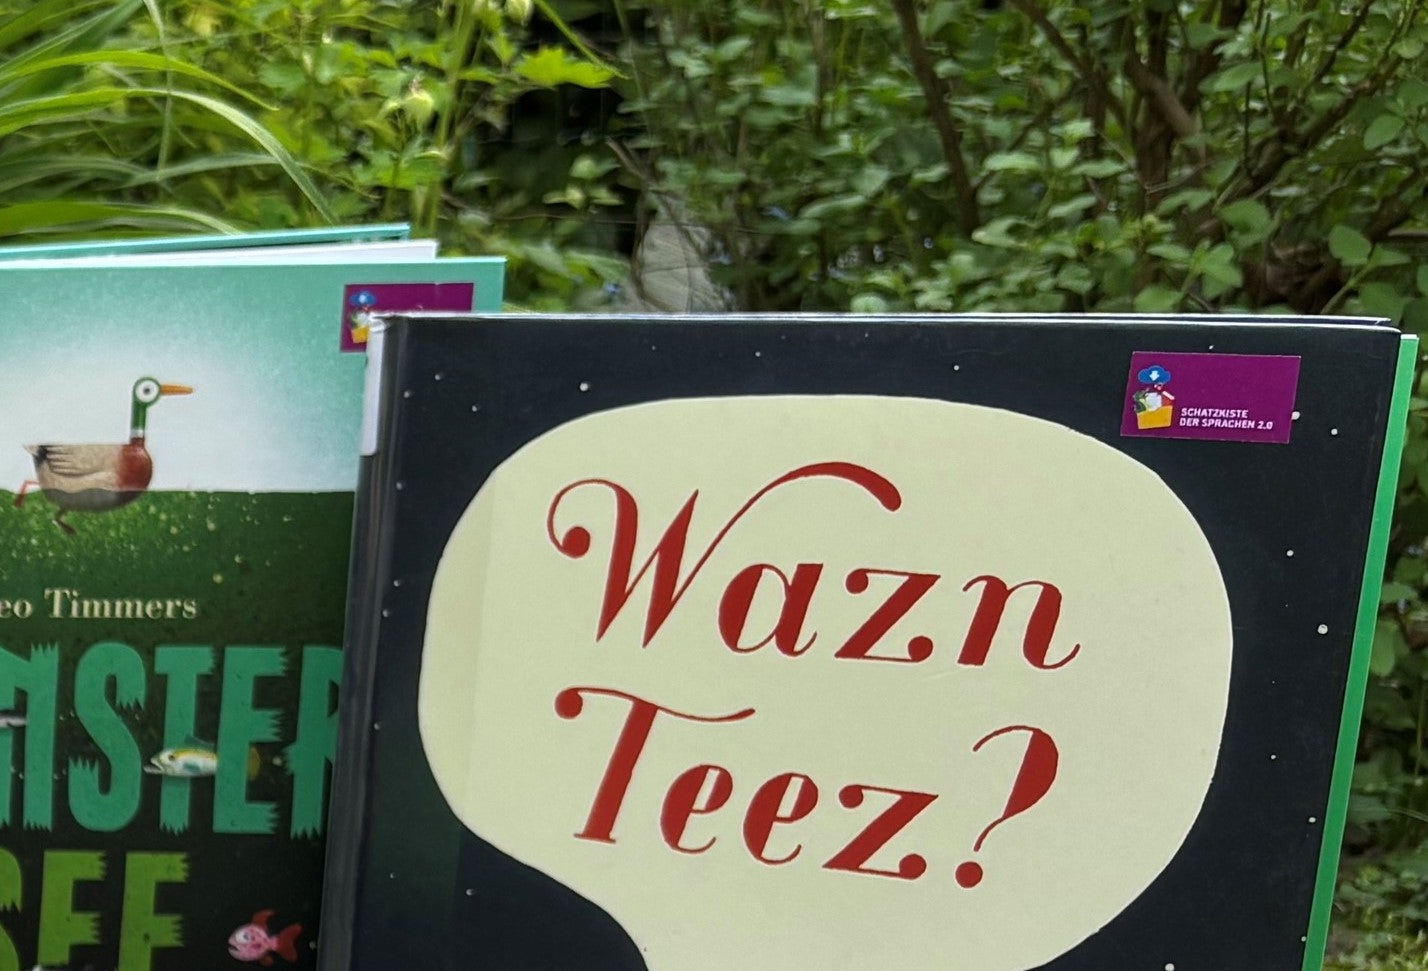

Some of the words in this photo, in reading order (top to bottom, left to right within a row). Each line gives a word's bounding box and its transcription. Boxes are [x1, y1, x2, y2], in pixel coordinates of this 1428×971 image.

[1179, 417, 1200, 427] DER
[1202, 418, 1255, 429] SPRACHEN
[1257, 421, 1273, 430] 2.0
[1181, 407, 1249, 419] SCHATZKISTE
[547, 461, 1081, 670] Wazn
[44, 587, 197, 620] Timmers
[554, 685, 1060, 889] Teez?
